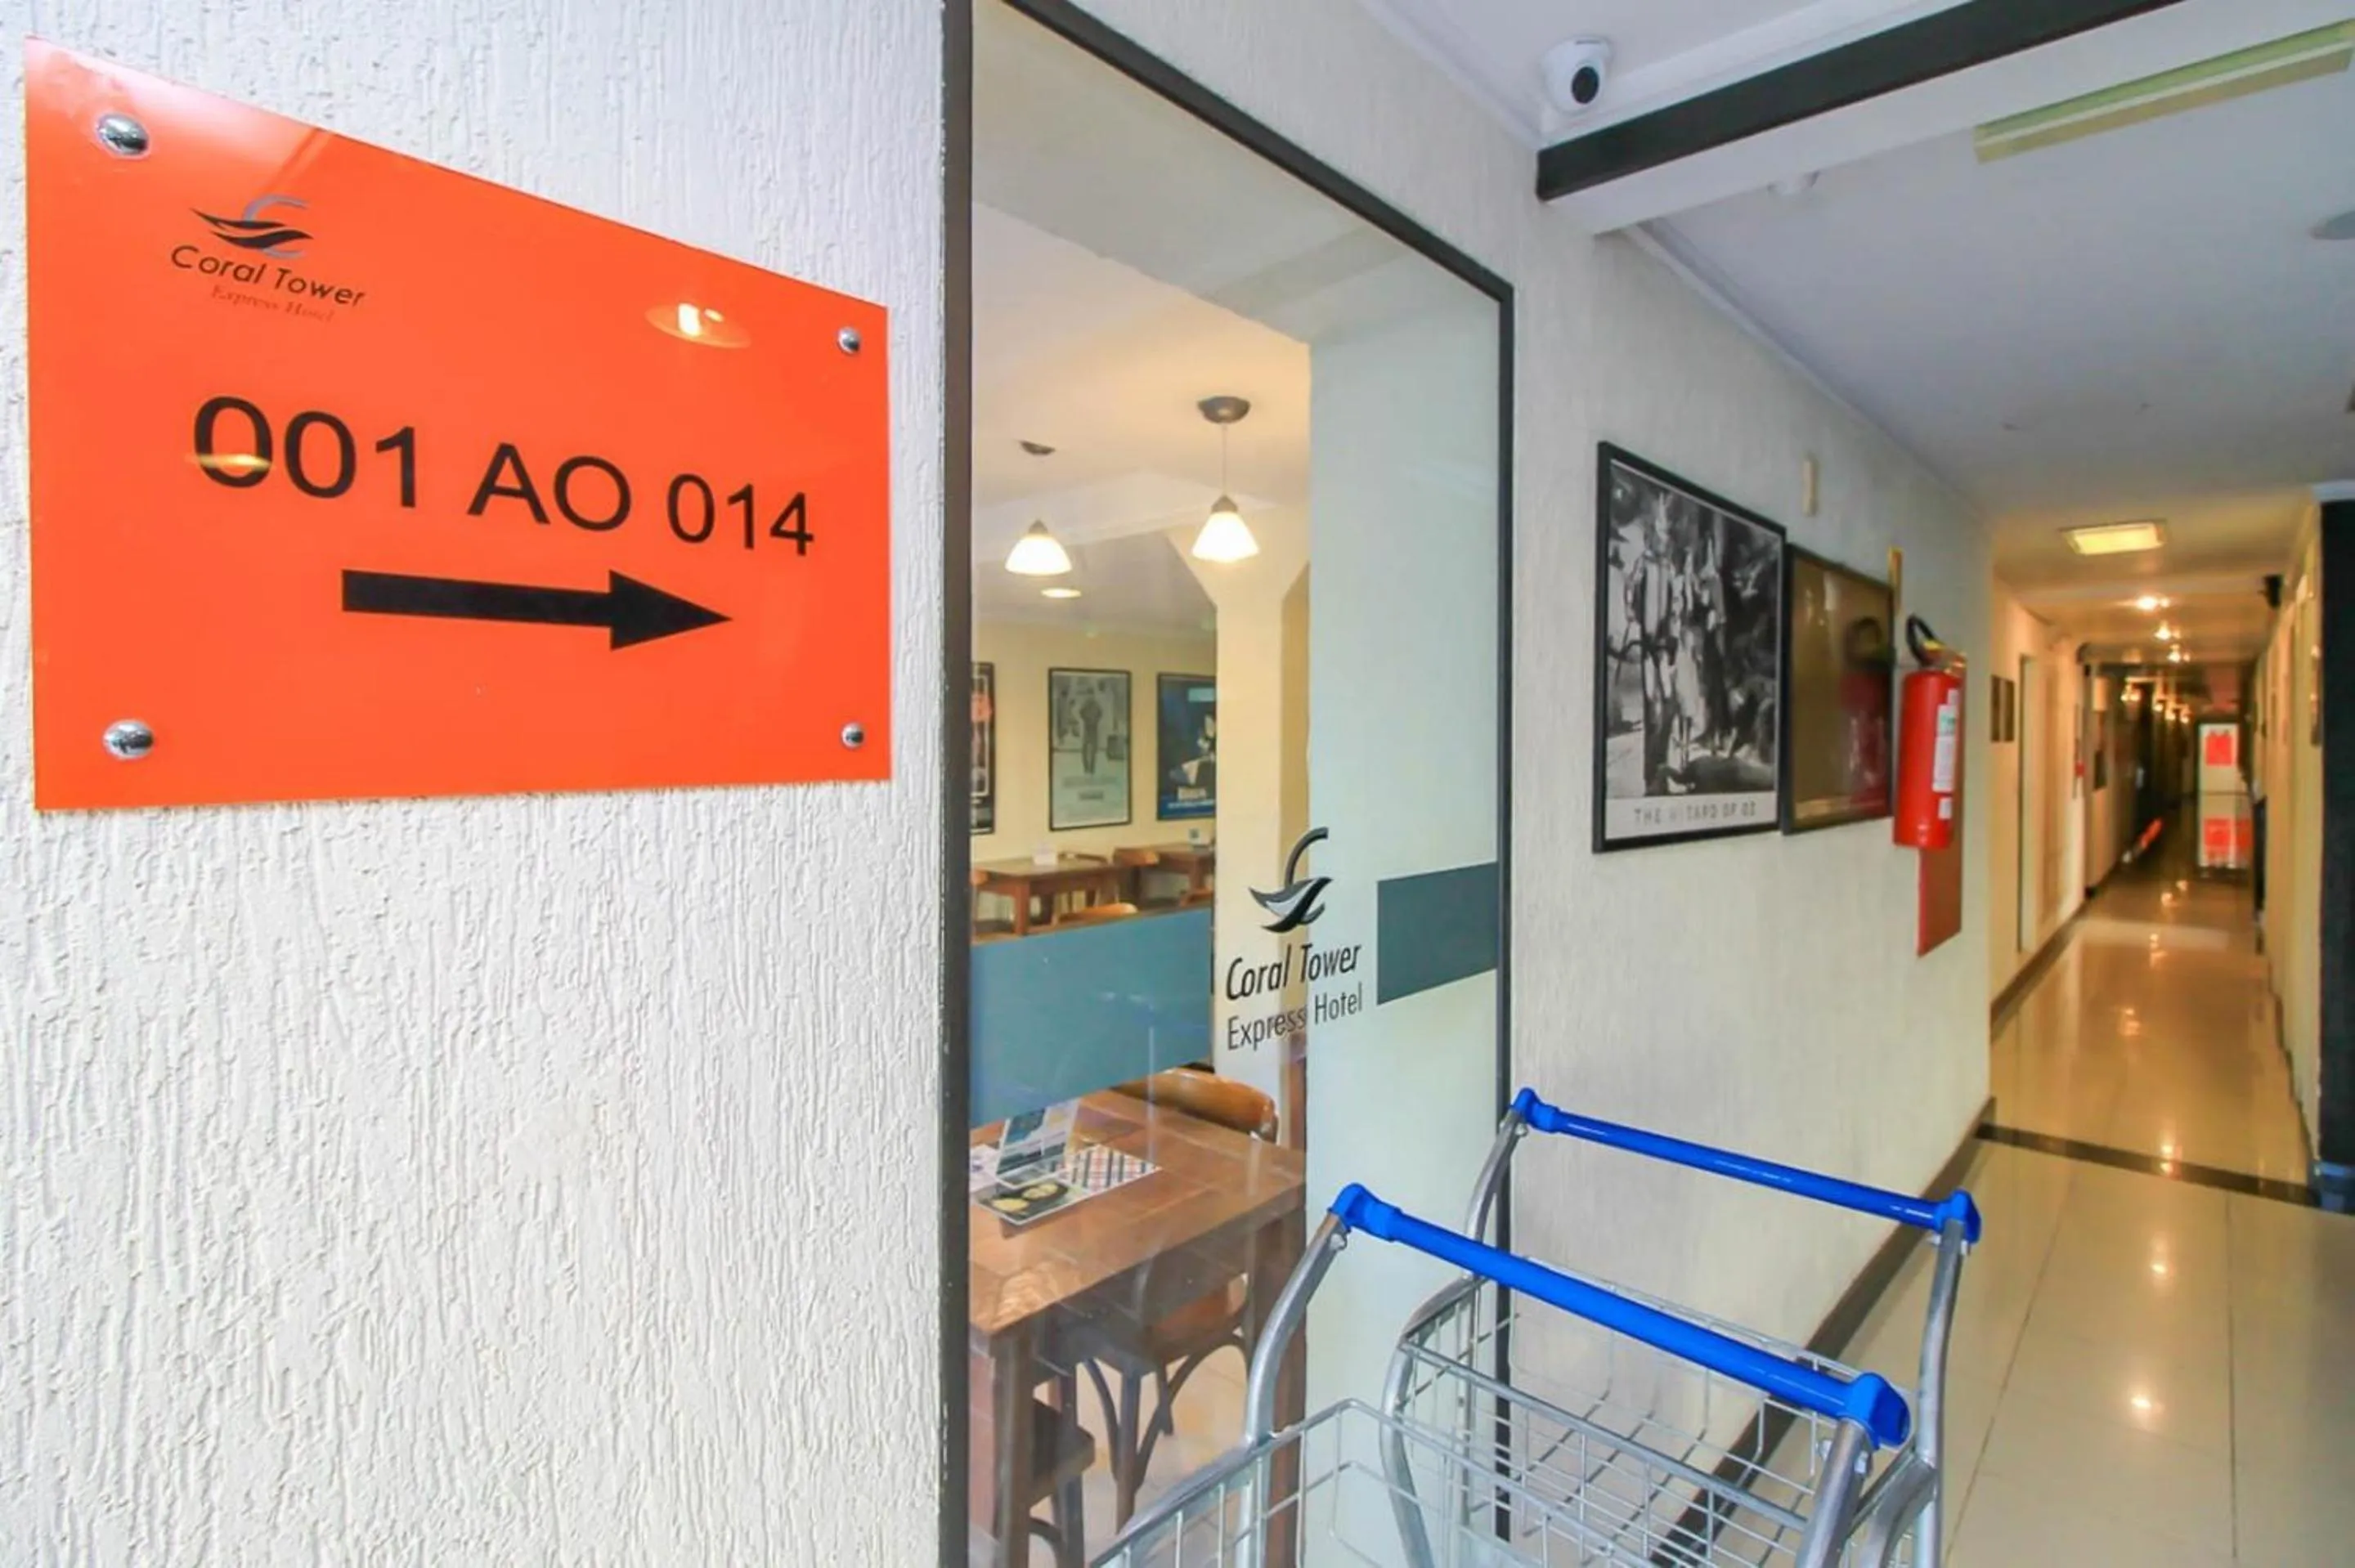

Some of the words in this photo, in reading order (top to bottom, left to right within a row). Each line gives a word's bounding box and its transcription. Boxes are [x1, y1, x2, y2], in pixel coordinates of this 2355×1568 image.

[170, 245, 267, 284] Coral
[274, 267, 365, 307] Tower
[193, 396, 417, 508] 001
[468, 441, 633, 532] AO
[666, 473, 814, 557] 014
[1226, 943, 1294, 1001] Coral
[1299, 943, 1362, 983] Tower
[1227, 1006, 1307, 1051] Express
[1313, 981, 1363, 1025] Hotel
